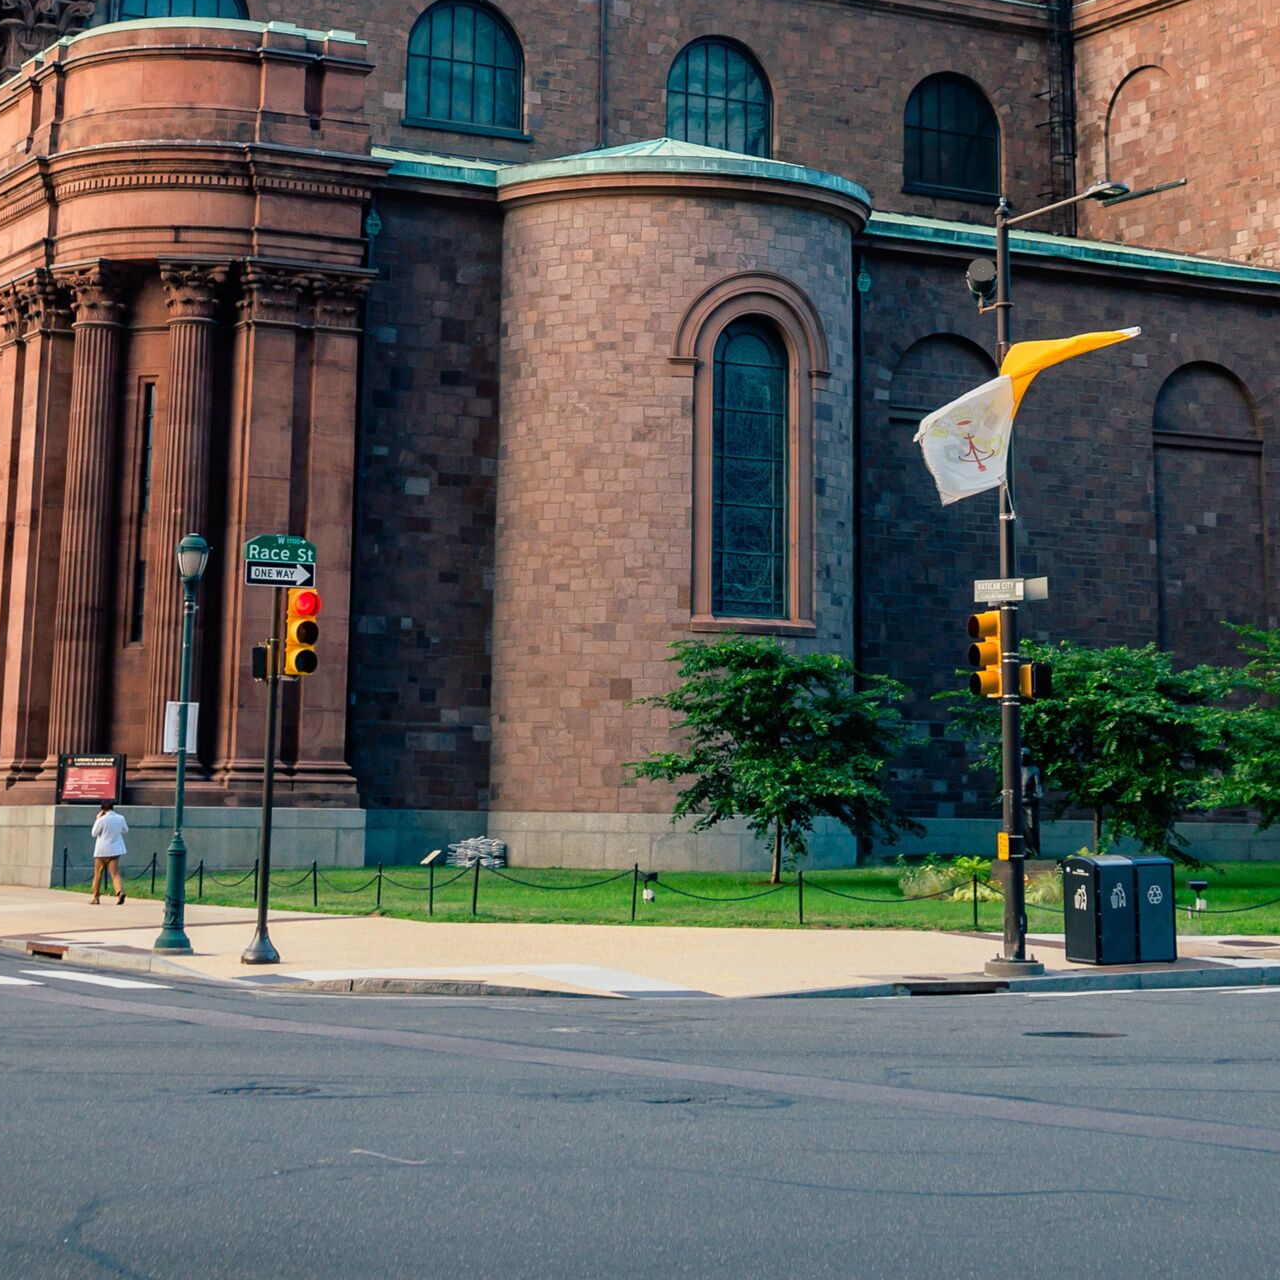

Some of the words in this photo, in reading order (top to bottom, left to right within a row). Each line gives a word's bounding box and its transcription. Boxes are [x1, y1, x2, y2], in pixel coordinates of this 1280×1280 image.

[277, 536, 286, 545] W
[249, 544, 290, 561] Race
[297, 548, 313, 562] St
[254, 567, 273, 578] ONE
[276, 569, 296, 579] WAY
[977, 582, 1001, 591] VATICAN
[1001, 581, 1015, 590] CITY
